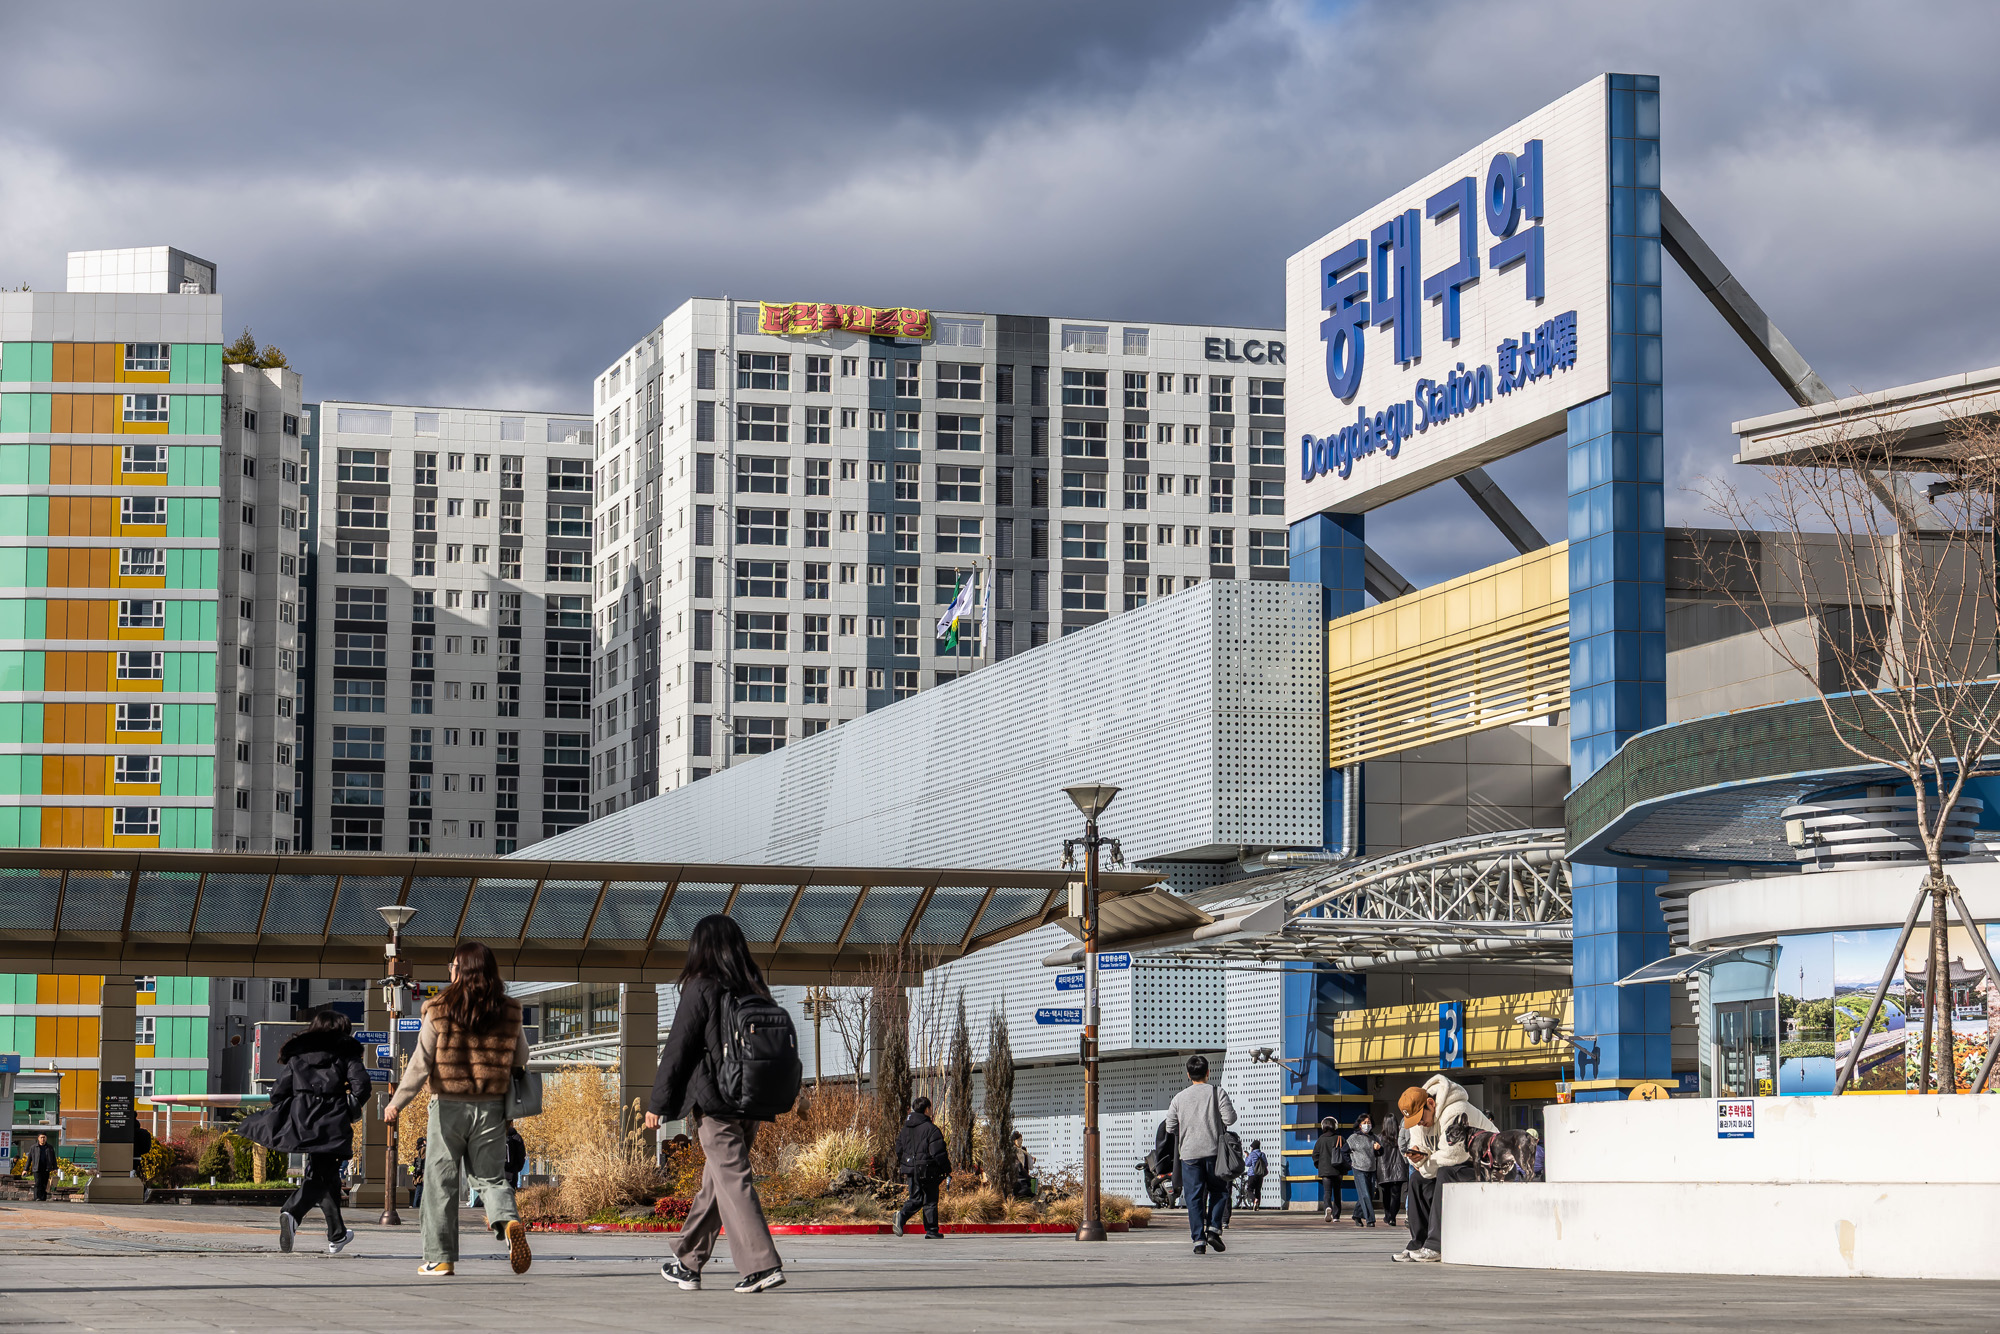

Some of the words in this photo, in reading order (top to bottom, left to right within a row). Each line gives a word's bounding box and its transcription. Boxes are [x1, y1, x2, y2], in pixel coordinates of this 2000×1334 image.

[1320, 139, 1545, 401] 동대구역
[1301, 399, 1414, 481] Dongdaegu
[1414, 361, 1493, 433] Station
[1496, 309, 1579, 395] 東大邱驛
[1445, 1008, 1459, 1062] 3
[1720, 1120, 1738, 1129] 올라가지
[1738, 1120, 1752, 1129] 마시오
[1728, 1104, 1752, 1118] 추락위험
